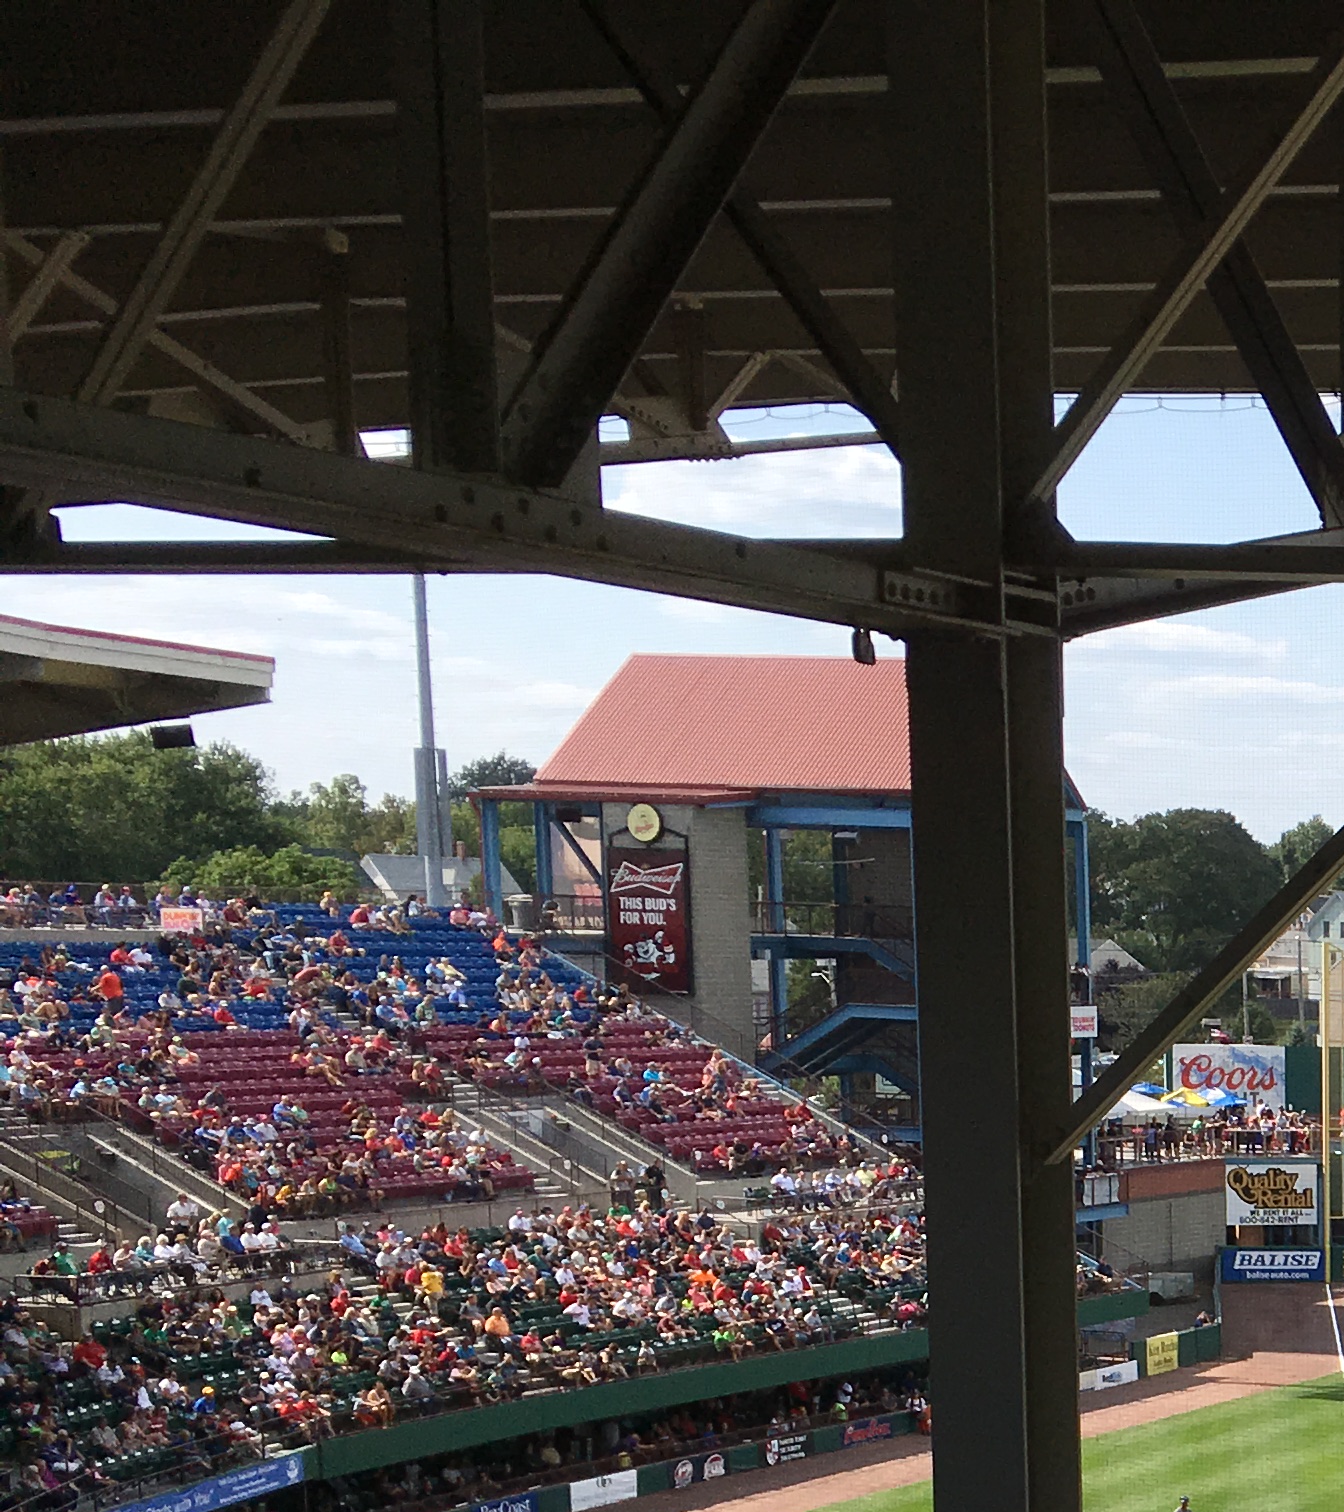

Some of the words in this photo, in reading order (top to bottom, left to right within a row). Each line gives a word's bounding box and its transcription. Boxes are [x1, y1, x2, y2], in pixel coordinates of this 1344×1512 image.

[611, 868, 681, 884] Budweiser
[619, 897, 642, 910] THIS
[645, 898, 676, 911] BUD'S
[620, 911, 640, 924] FOR
[643, 912, 666, 925] YOU.
[1179, 1054, 1278, 1090] Coors
[1227, 1167, 1299, 1205] Quality
[1254, 1188, 1315, 1210] Rental
[1238, 1254, 1318, 1267] BALISE
[1246, 1271, 1310, 1279] baliseauto.com
